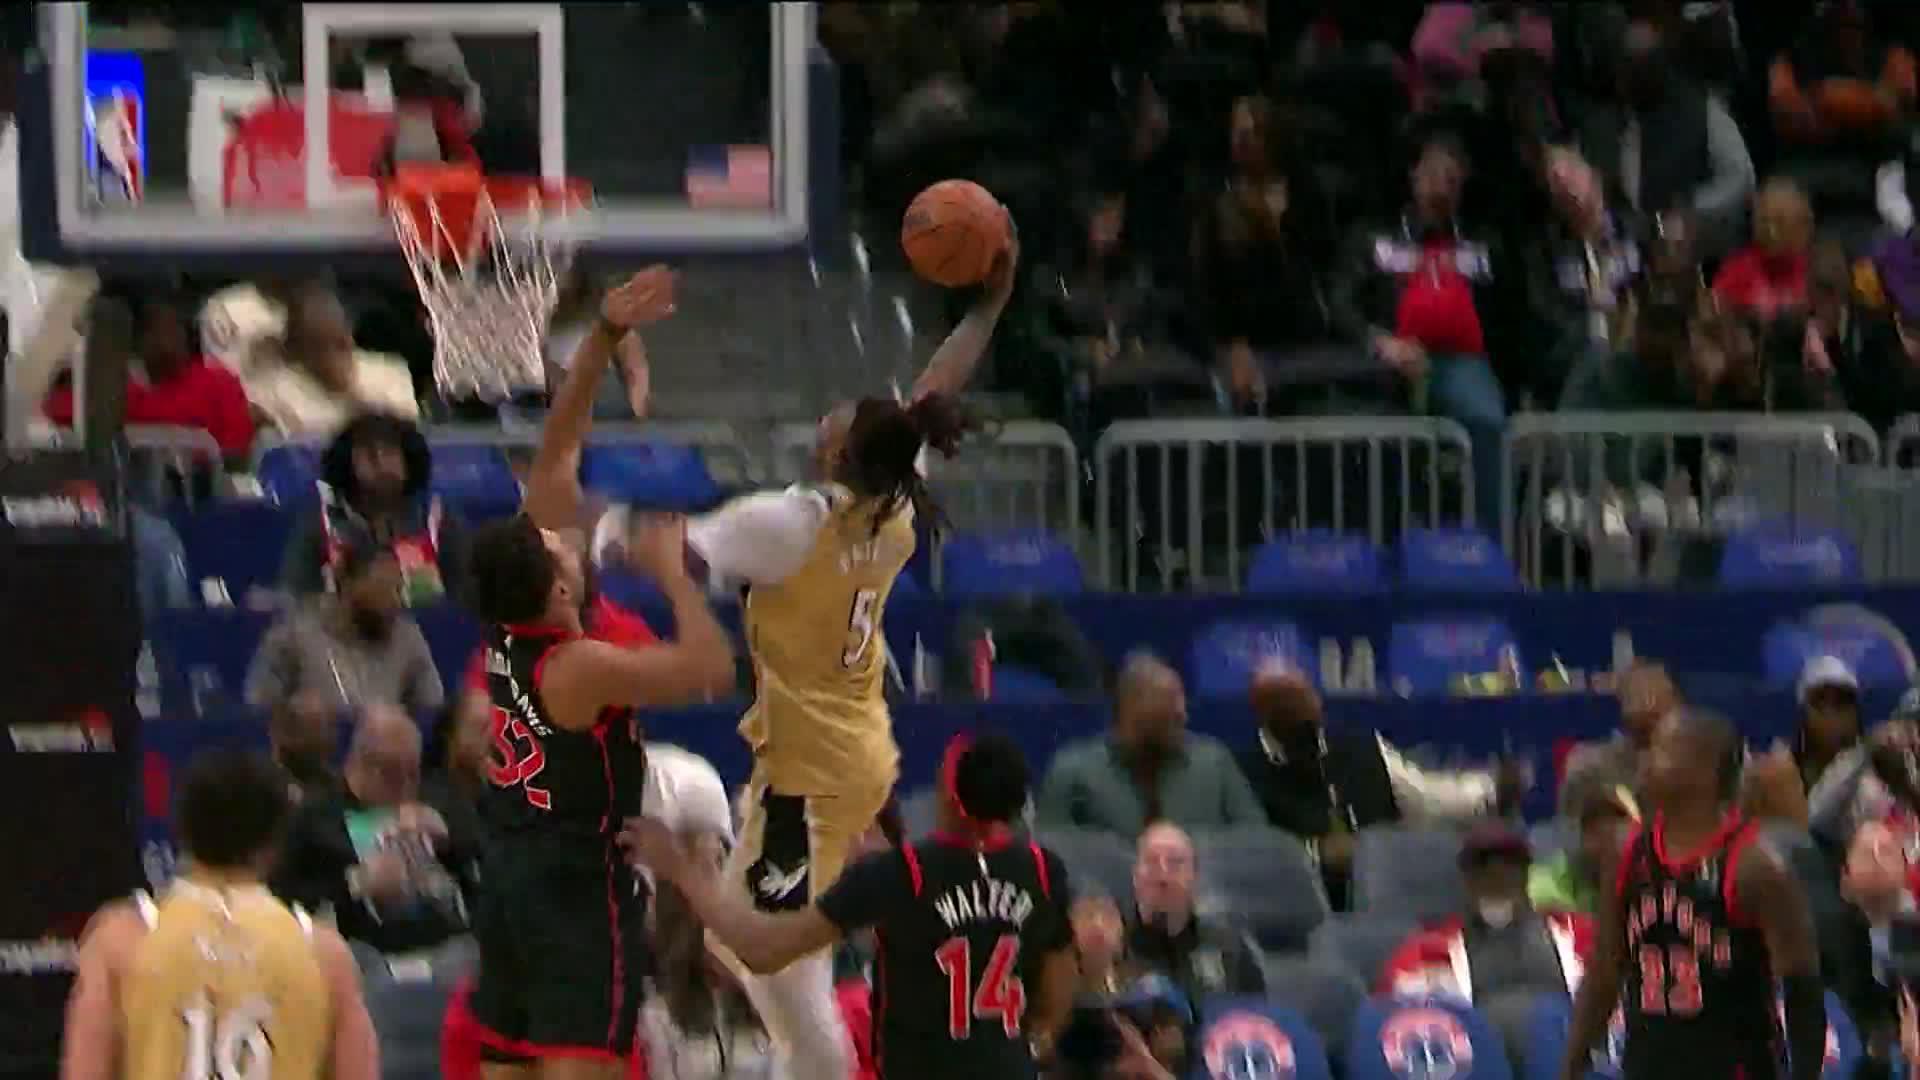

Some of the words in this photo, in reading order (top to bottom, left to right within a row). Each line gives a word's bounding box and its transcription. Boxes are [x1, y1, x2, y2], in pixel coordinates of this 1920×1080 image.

[843, 589, 878, 669] 5
[934, 877, 1034, 932] WALTER
[934, 933, 1027, 1040] 14
